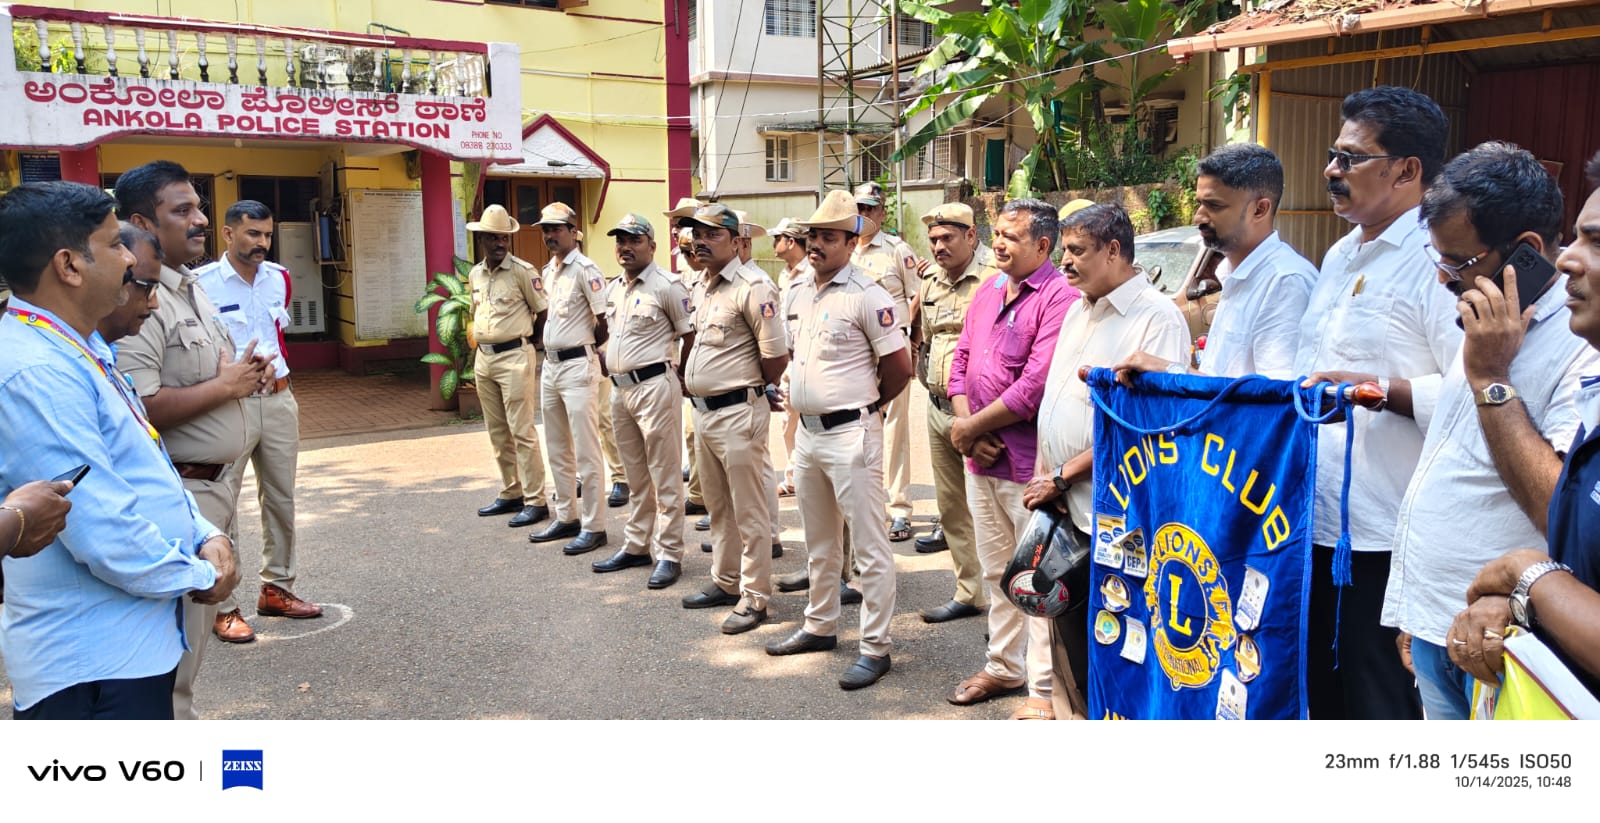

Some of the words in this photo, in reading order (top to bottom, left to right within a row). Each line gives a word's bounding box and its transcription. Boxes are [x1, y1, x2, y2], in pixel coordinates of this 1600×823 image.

[24, 77, 224, 110] ಅಂಕೋಲಾ
[241, 87, 400, 118] ಪೊಲೀಸ್
[415, 98, 486, 122] ಠಾಣೆ
[83, 108, 203, 130] ANKOLA
[217, 114, 320, 134] POLICE
[335, 119, 451, 139] STATION
[460, 141, 484, 150] 08388
[471, 130, 490, 139] PHONE
[492, 131, 503, 139] NO
[1201, 432, 1290, 552] CLUB
[1157, 531, 1214, 577] LIONS
[1168, 573, 1193, 636] L
